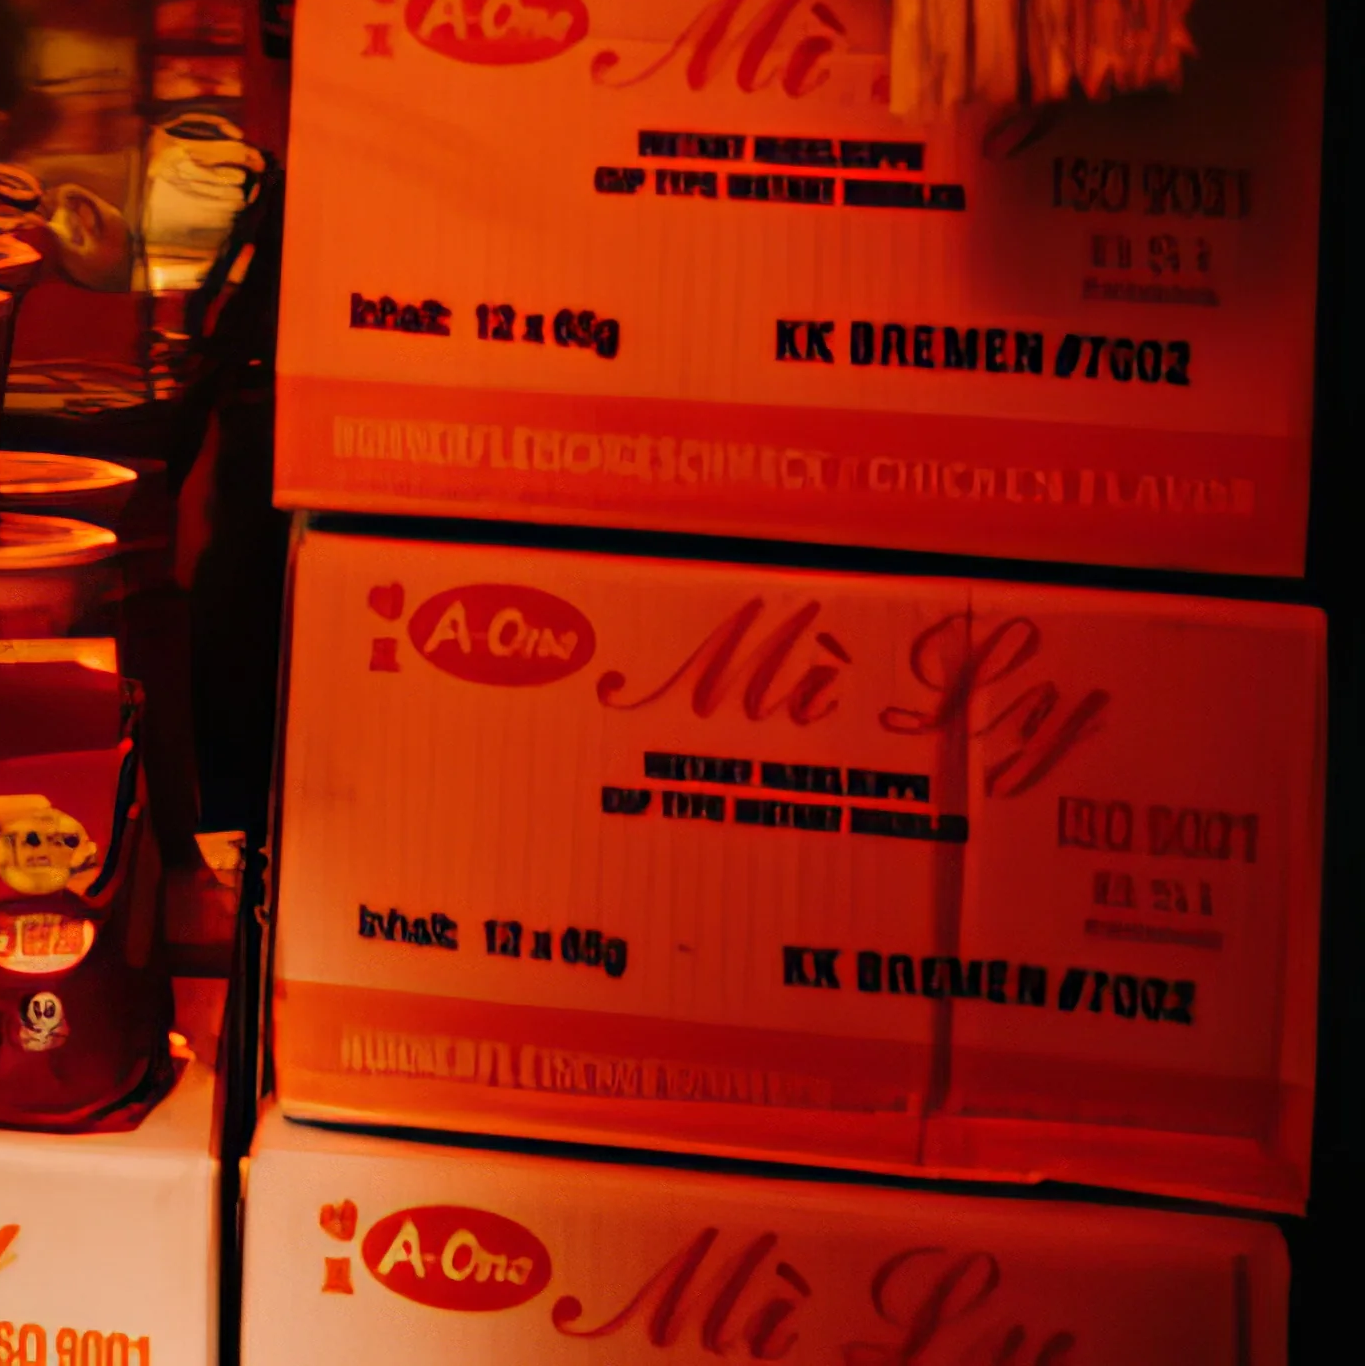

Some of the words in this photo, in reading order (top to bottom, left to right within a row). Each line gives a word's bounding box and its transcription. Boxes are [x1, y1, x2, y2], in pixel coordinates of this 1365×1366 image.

[774, 318, 835, 366] KK
[849, 320, 1044, 375] BREMEN
[597, 593, 851, 727] Mì
[783, 945, 838, 992] KK
[856, 950, 1046, 1007] BREMEN
[552, 1226, 811, 1361] Mì
[56, 1327, 149, 1366] 9001
